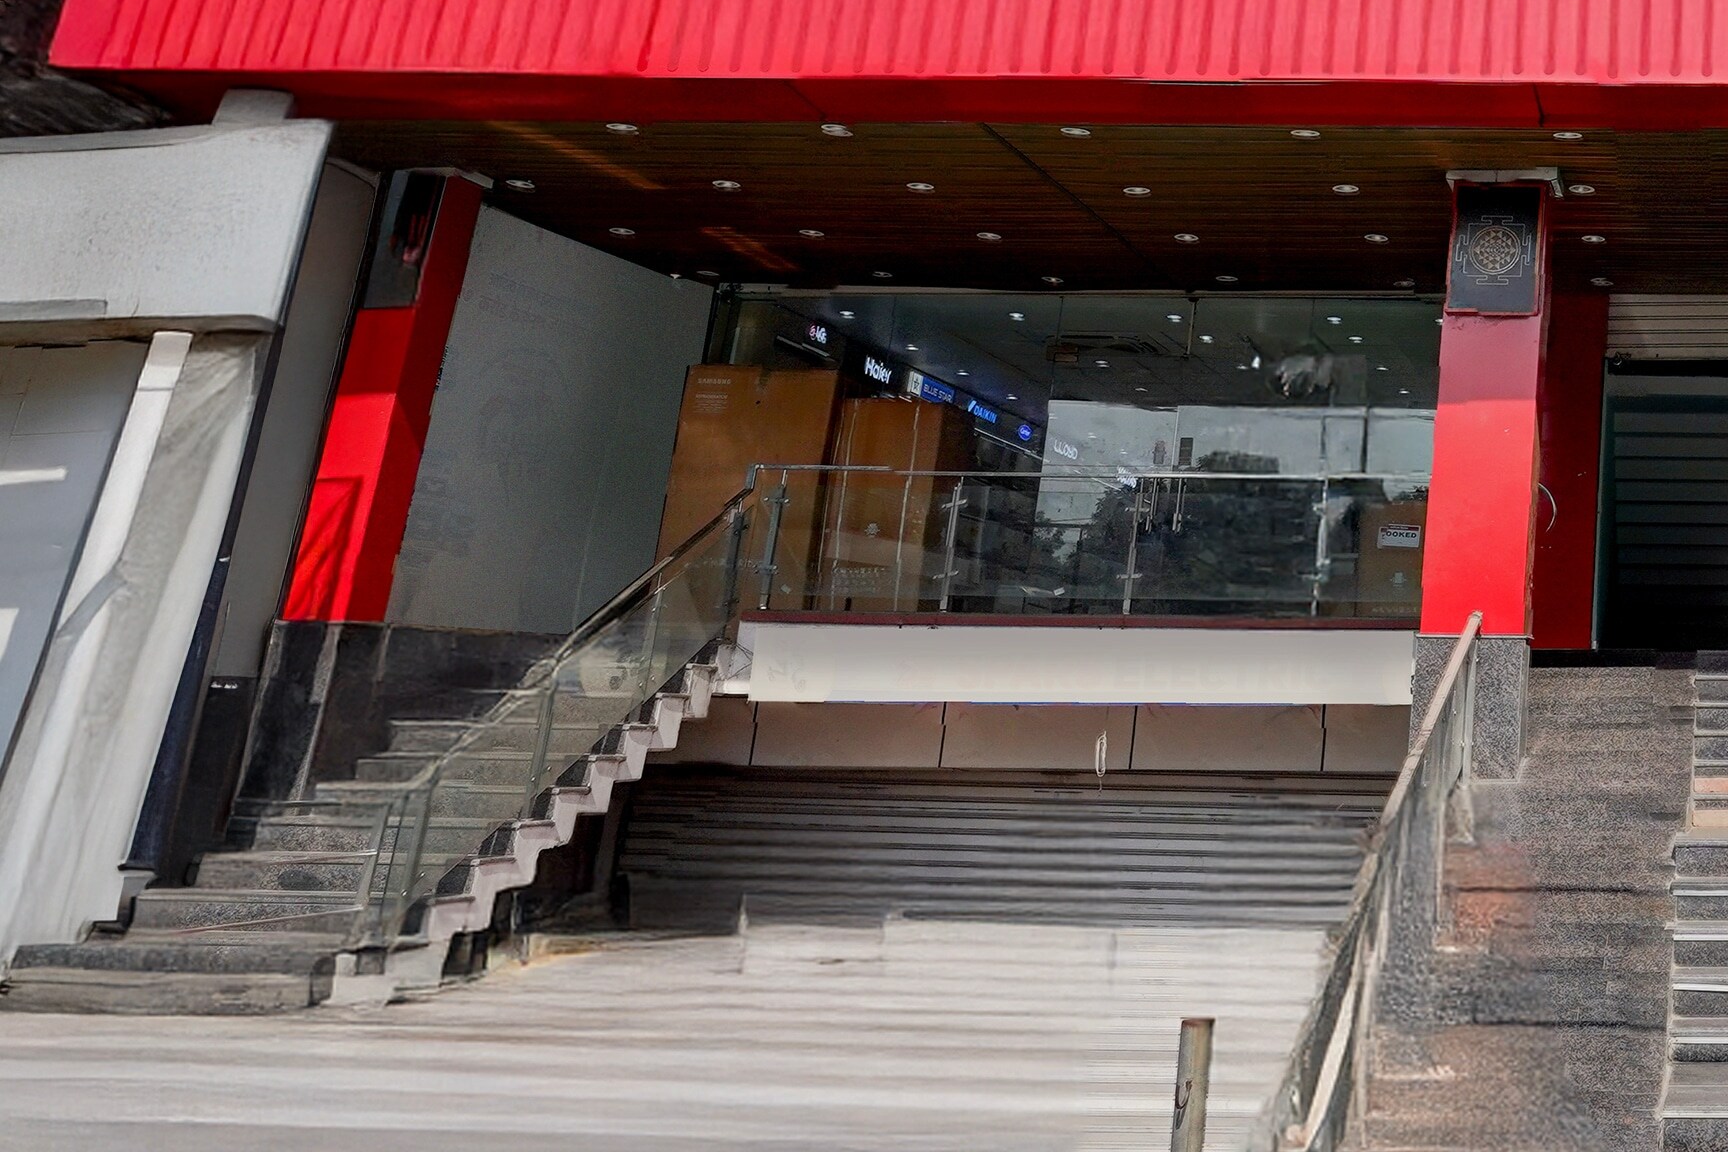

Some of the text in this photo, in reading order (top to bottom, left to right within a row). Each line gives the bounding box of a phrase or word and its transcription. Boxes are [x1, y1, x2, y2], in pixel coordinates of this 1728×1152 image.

[864, 355, 892, 384] Haier
[973, 405, 998, 424] DAIKIN
[1382, 530, 1417, 539] OOKED
